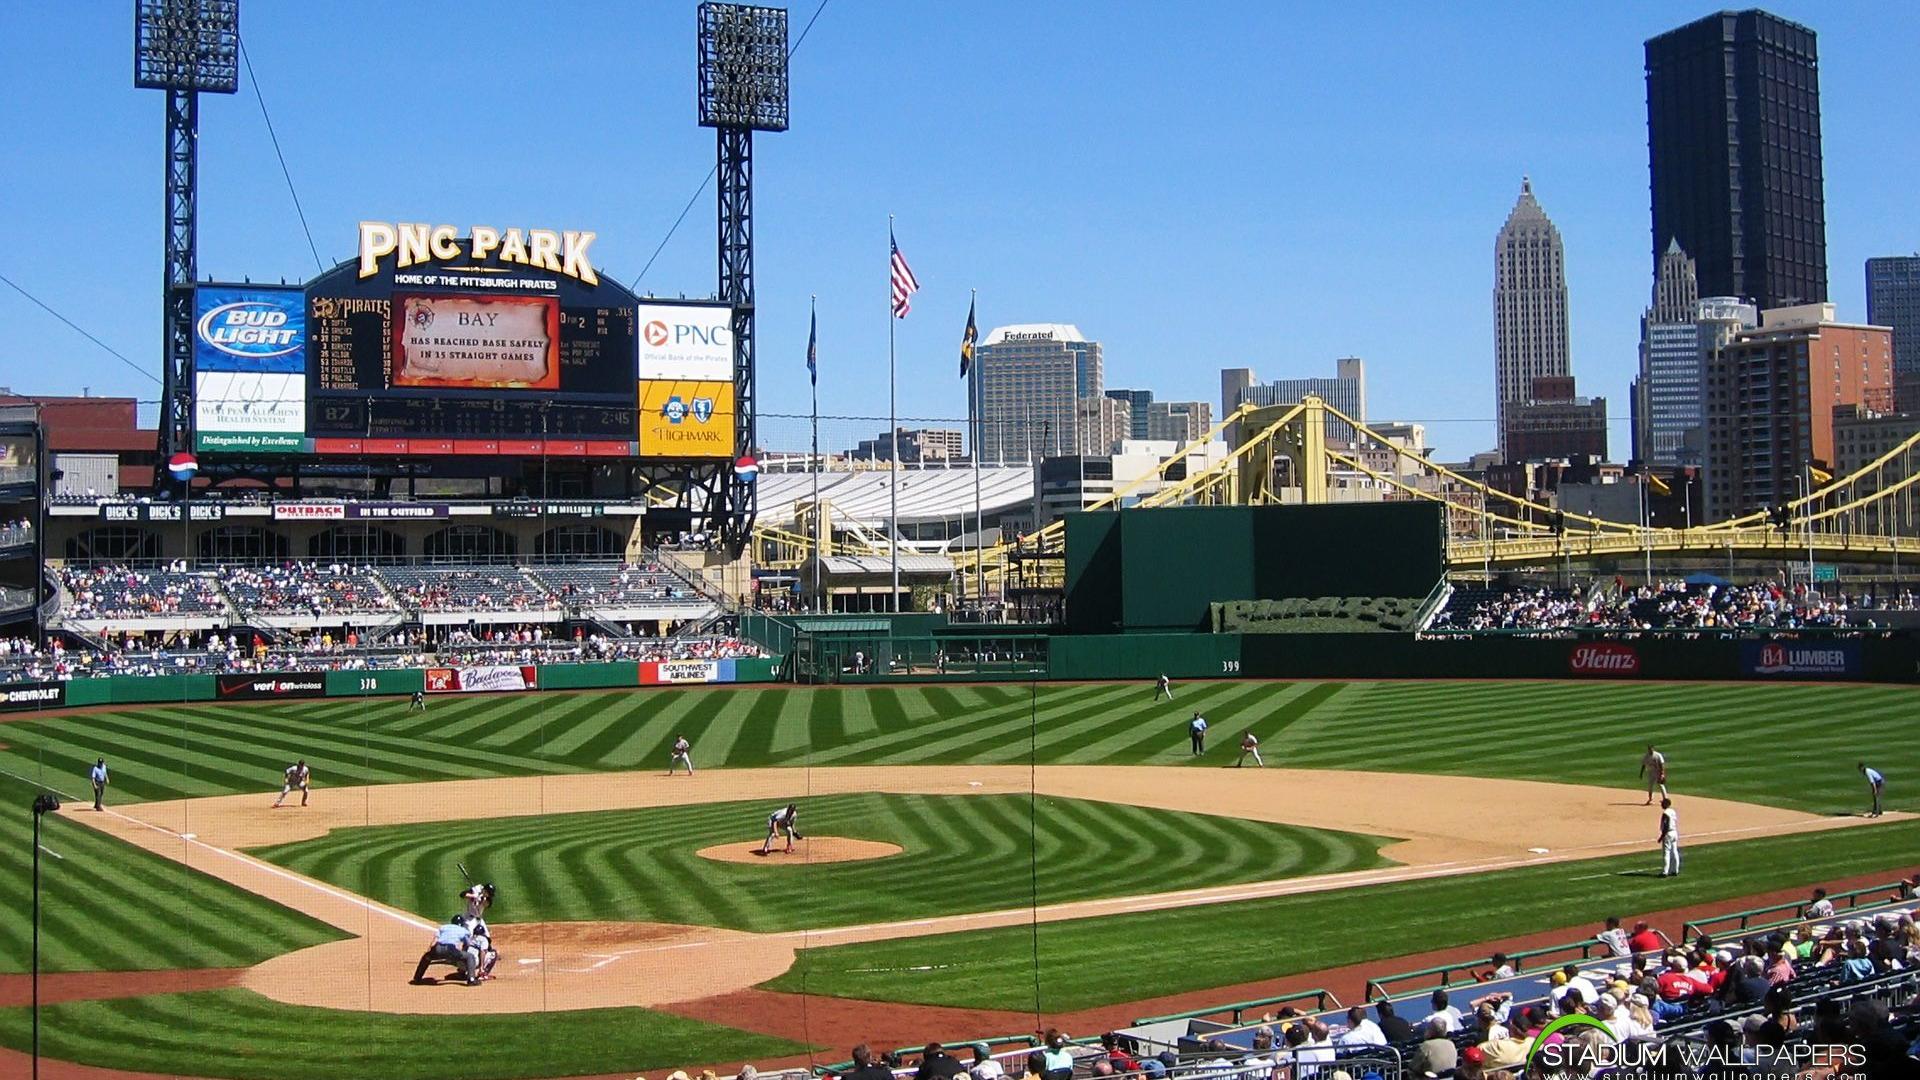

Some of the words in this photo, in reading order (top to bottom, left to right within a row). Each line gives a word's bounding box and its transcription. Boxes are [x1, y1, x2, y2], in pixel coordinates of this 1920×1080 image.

[359, 221, 461, 279] PNC
[471, 226, 598, 287] PARK
[394, 274, 423, 285] HOME
[424, 275, 437, 285] OF
[439, 275, 459, 286] THE
[460, 276, 518, 289] PITTSBURGH
[519, 278, 557, 290] PIRATES
[344, 299, 391, 319] PIRATES
[225, 310, 288, 327] BUD
[458, 312, 499, 327] BAY
[578, 317, 585, 328] 2
[213, 327, 298, 345] LIGHT
[673, 324, 727, 345] PNC
[1004, 331, 1053, 341] Federated
[434, 338, 479, 346] REACHED
[482, 339, 507, 347] BASE
[509, 339, 544, 348] SAFELY
[420, 350, 431, 358] IN
[449, 351, 498, 360] STRAIGHT
[500, 353, 534, 361] GAMES
[227, 407, 248, 415] PEN
[250, 407, 300, 416] ALLEGHENY
[325, 407, 350, 421] 87
[217, 415, 251, 423] HEALTH
[252, 416, 286, 424] SYSTEM
[601, 411, 630, 425] 2:45
[202, 435, 251, 446] Distinguished
[251, 436, 260, 446] by
[261, 436, 299, 446] Excellence
[657, 429, 721, 441] HIGHMARK
[106, 506, 138, 517] DICK'S
[149, 506, 180, 517] DICK'S
[190, 506, 221, 517] DICK'S
[277, 506, 343, 514] OUTBACK
[360, 508, 371, 516] IN
[371, 508, 389, 516] THE
[391, 508, 434, 516] OUTFIELD
[559, 505, 592, 514] MILLION
[1571, 648, 1636, 669] Heinz
[1763, 648, 1783, 665] 84
[1789, 650, 1845, 665] LUMBER
[663, 663, 712, 672] SOUTHWEST
[1222, 660, 1240, 672] 399
[670, 671, 706, 679] AIRLINES
[253, 680, 294, 693] verizon
[360, 678, 377, 690] 378
[10, 688, 60, 702] CHEVROLET
